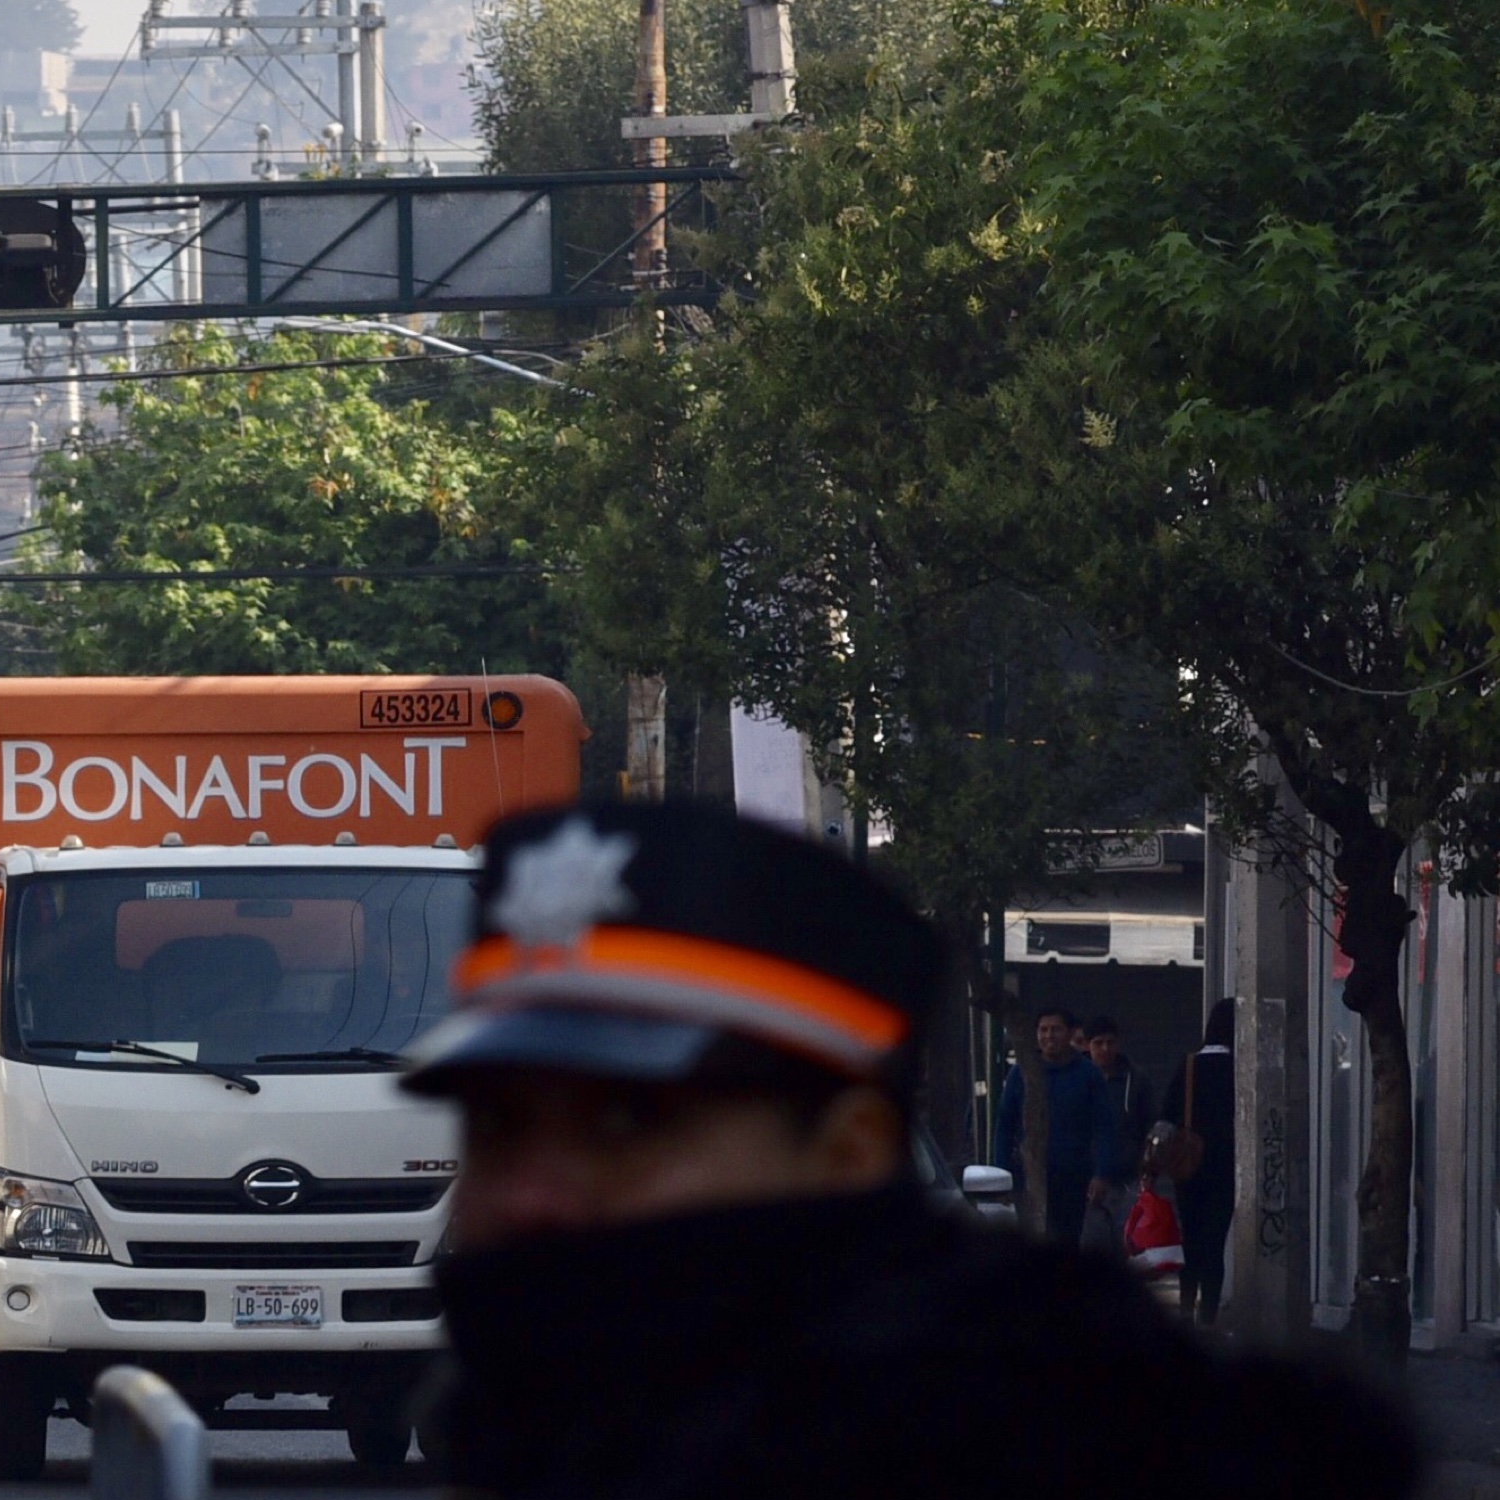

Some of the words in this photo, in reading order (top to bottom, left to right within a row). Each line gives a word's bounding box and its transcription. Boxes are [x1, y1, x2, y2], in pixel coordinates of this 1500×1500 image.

[370, 694, 460, 723] 453324
[1, 736, 467, 822] BONAFONT
[91, 1160, 159, 1173] HINO
[236, 1297, 320, 1317] LB-50-699
